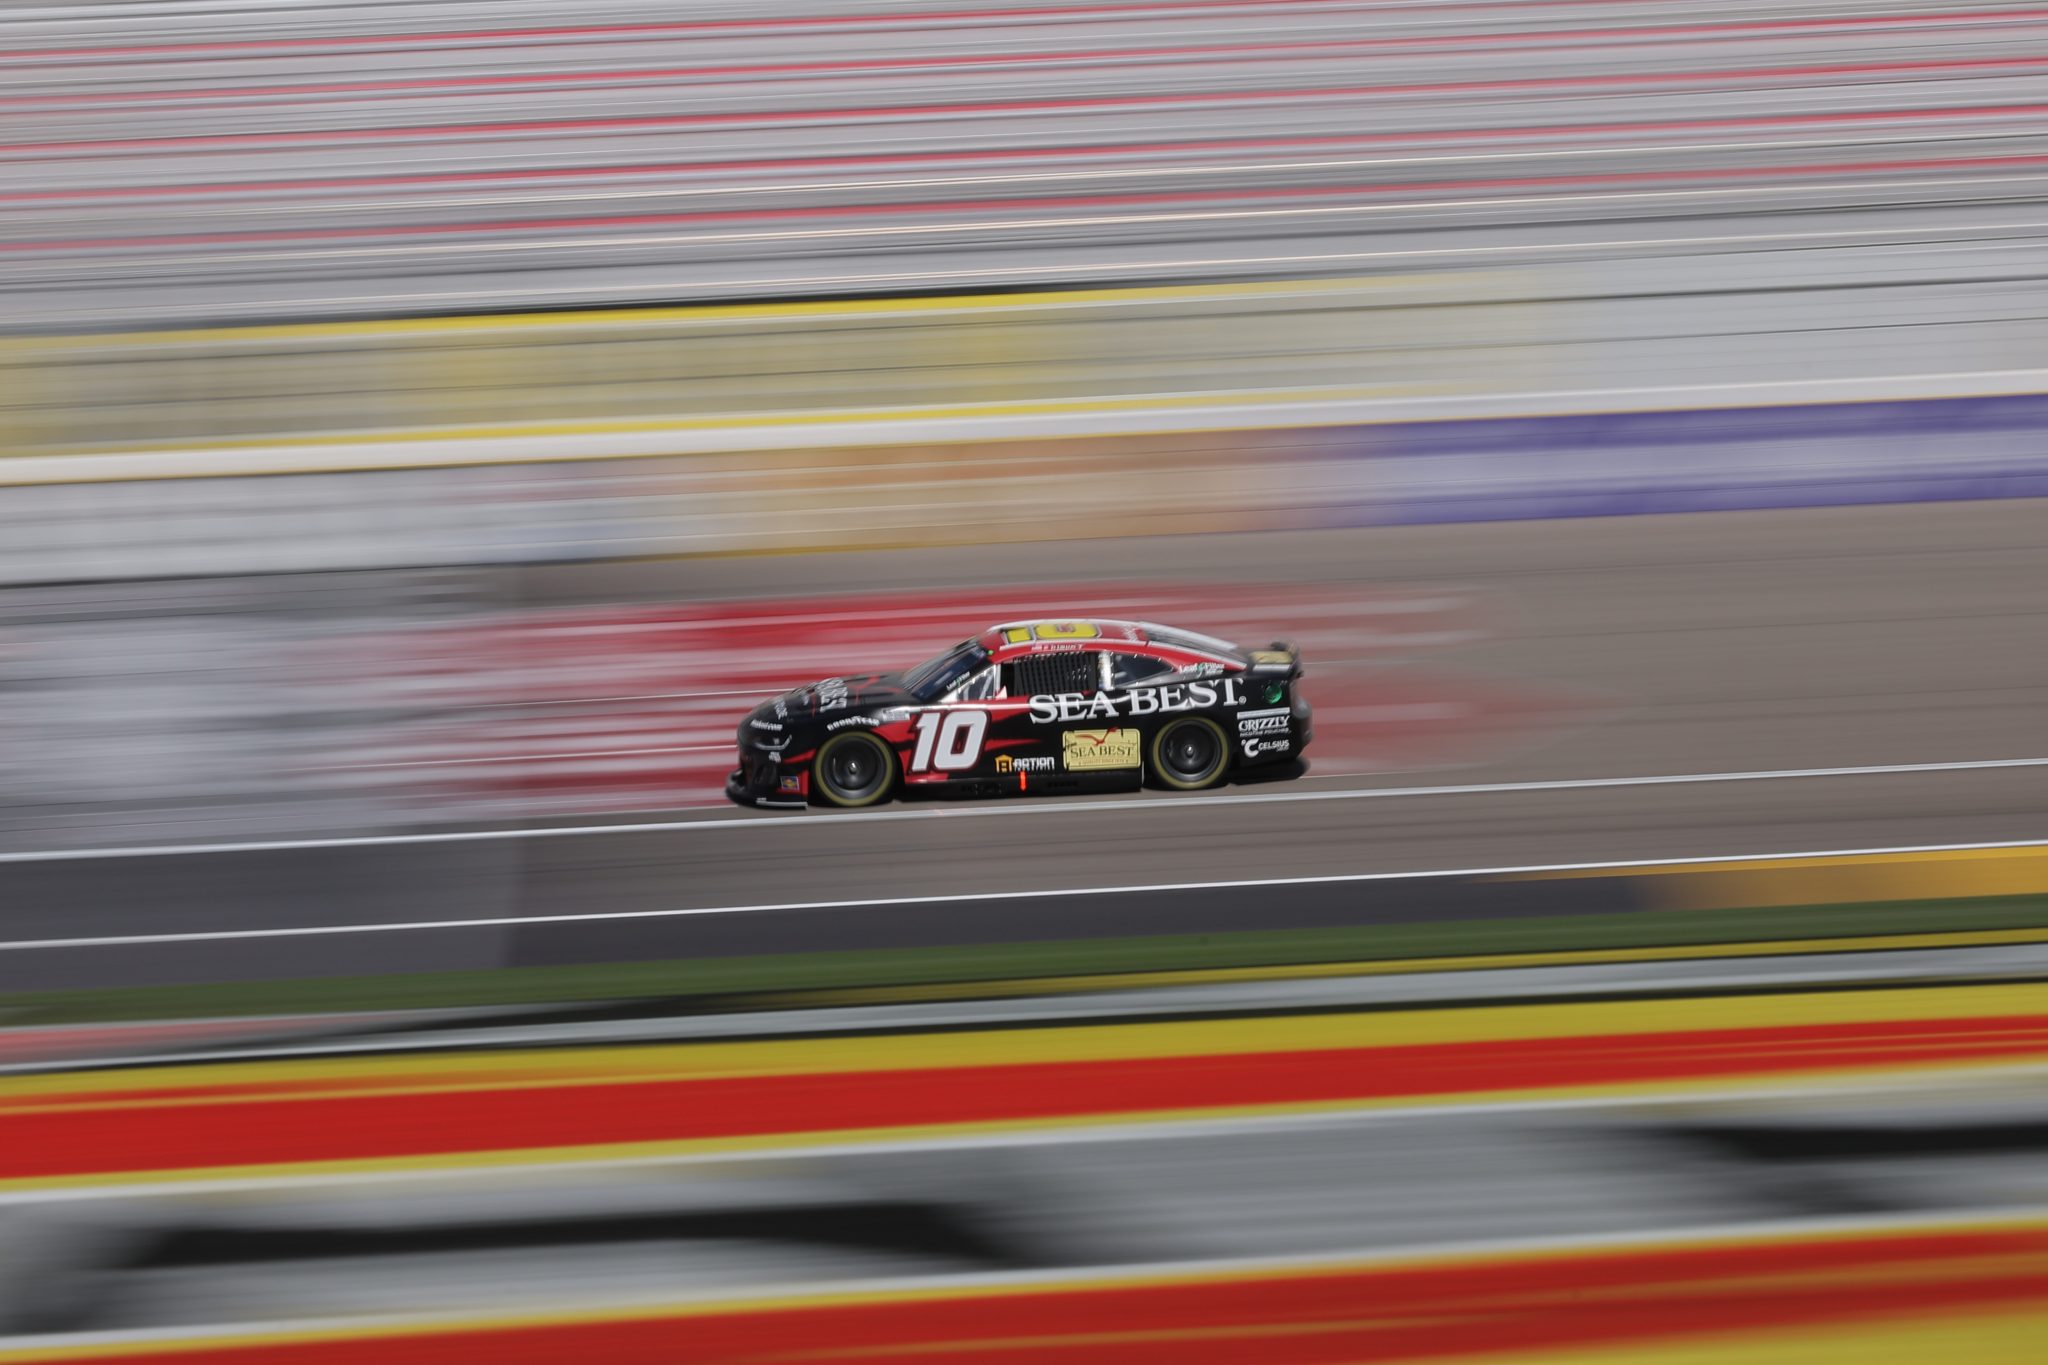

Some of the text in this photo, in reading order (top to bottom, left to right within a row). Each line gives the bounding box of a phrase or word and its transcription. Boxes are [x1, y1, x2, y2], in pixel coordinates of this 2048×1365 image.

[1029, 678, 1244, 724] SEA BEST
[1238, 715, 1290, 732] GRIZZLY
[911, 711, 988, 772] 10
[1258, 739, 1290, 751] CELSIUS
[1070, 745, 1135, 758] SEA BEST
